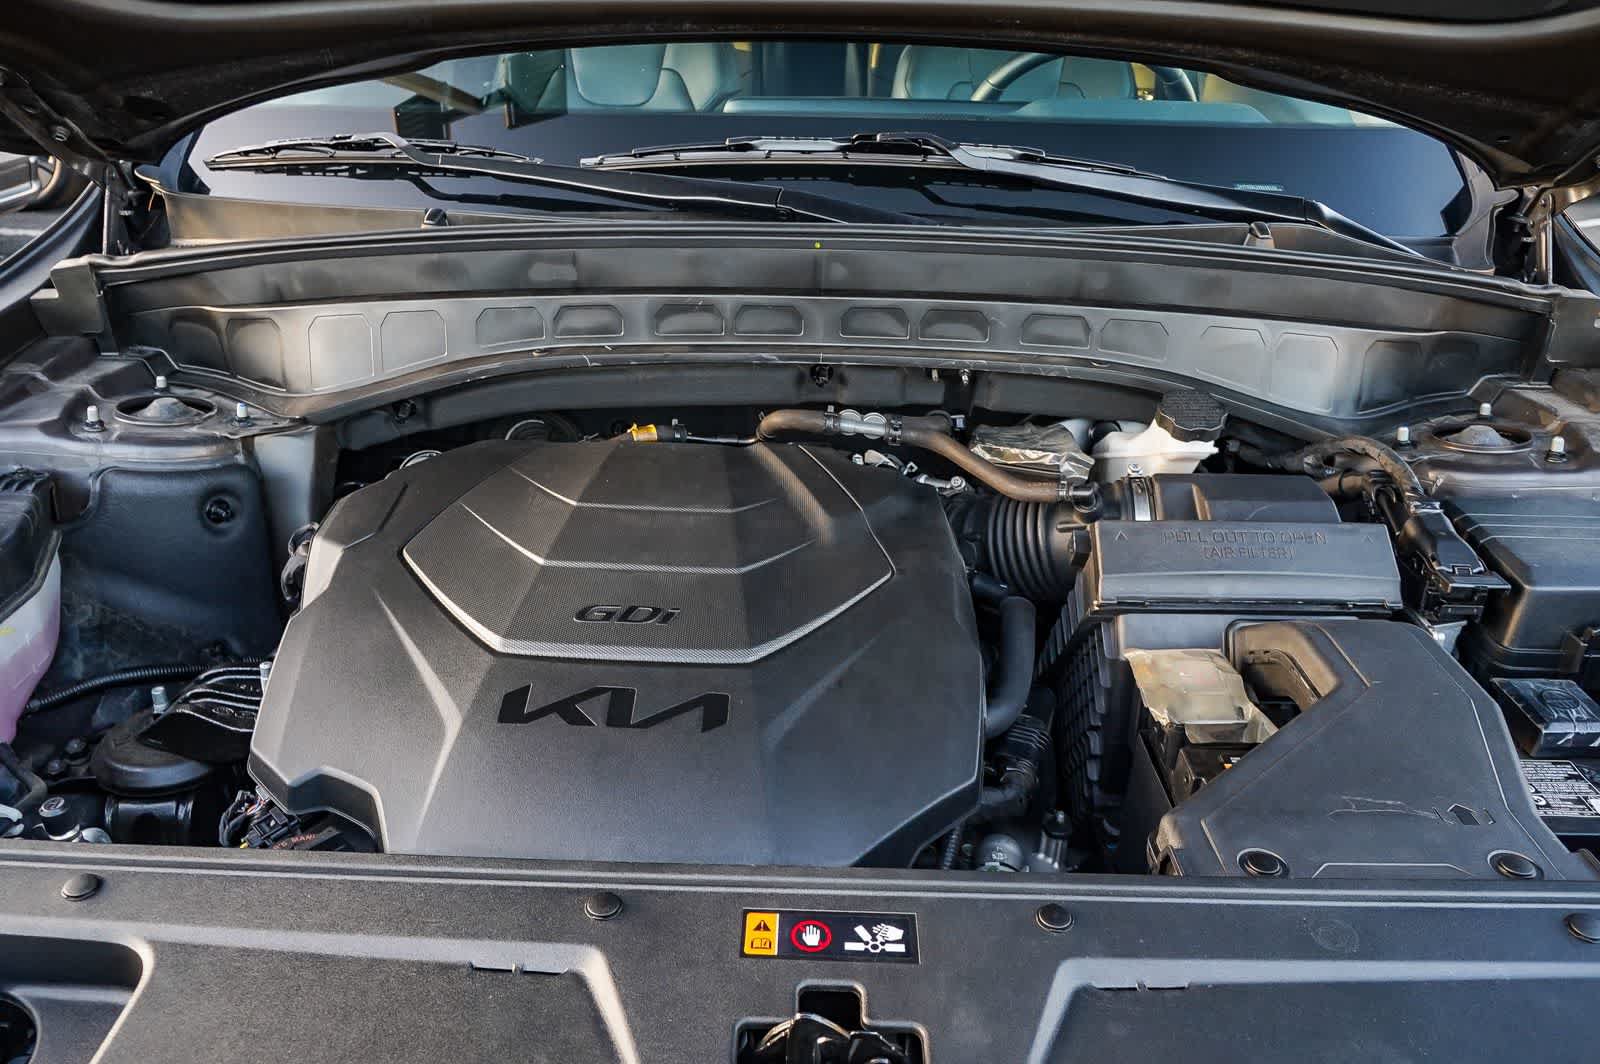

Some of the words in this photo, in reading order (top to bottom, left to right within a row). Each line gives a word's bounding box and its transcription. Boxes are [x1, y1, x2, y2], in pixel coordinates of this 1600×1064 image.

[1161, 529, 1208, 545] PULL
[1213, 529, 1248, 544] OUT
[1254, 529, 1276, 545] TO
[1280, 530, 1328, 545] OPEN
[573, 604, 681, 626] GDi
[497, 682, 731, 733] KIA
